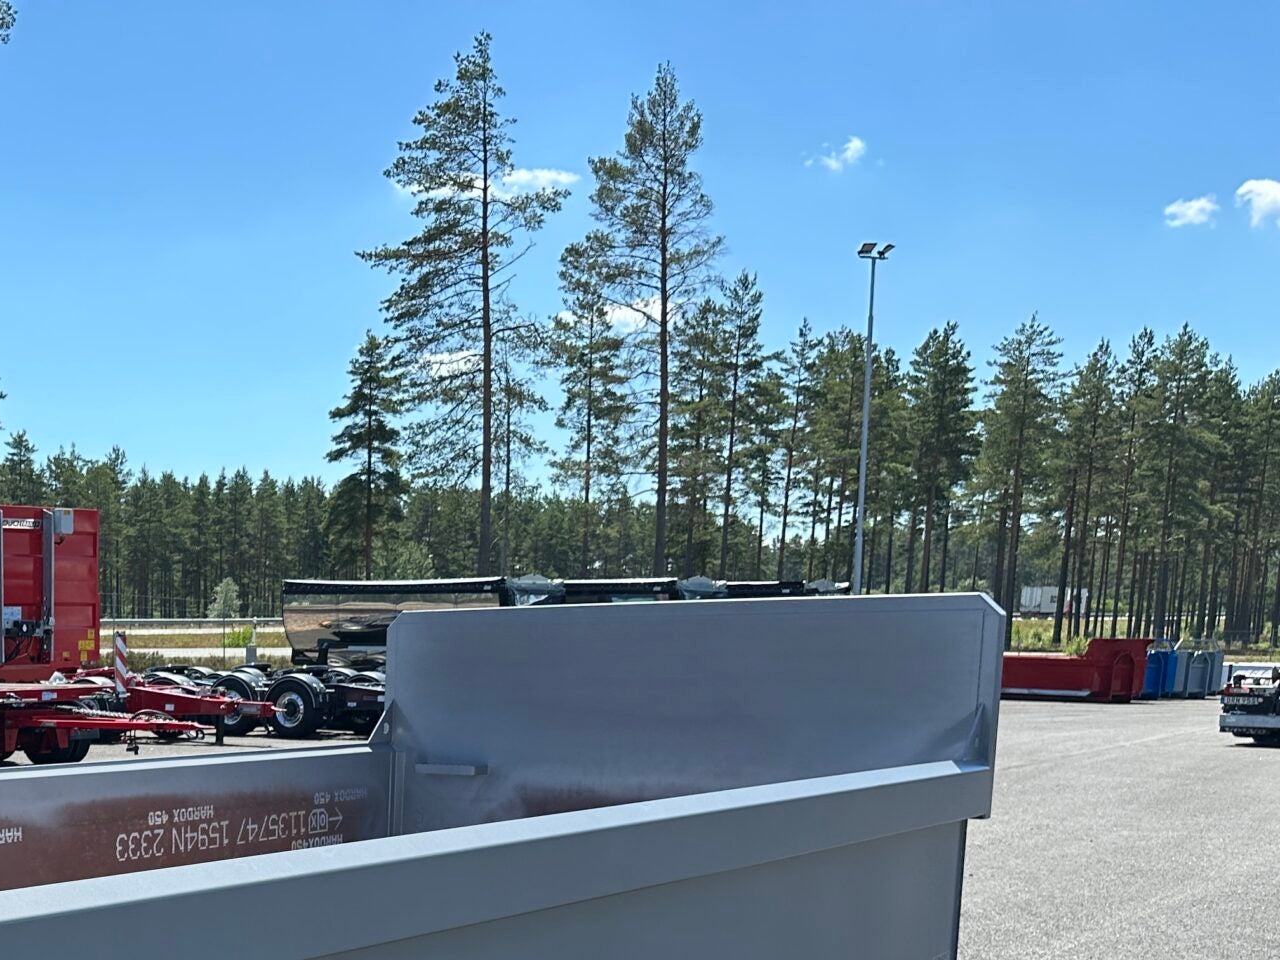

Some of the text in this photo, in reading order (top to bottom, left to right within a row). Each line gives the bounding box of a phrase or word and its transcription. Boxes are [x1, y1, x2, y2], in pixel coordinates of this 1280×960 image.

[314, 784, 368, 805] HARDOX 450
[148, 805, 214, 826] HARDOX 450
[237, 810, 306, 845] 1135747
[116, 829, 164, 862] 2333
[172, 820, 229, 854] 1594N
